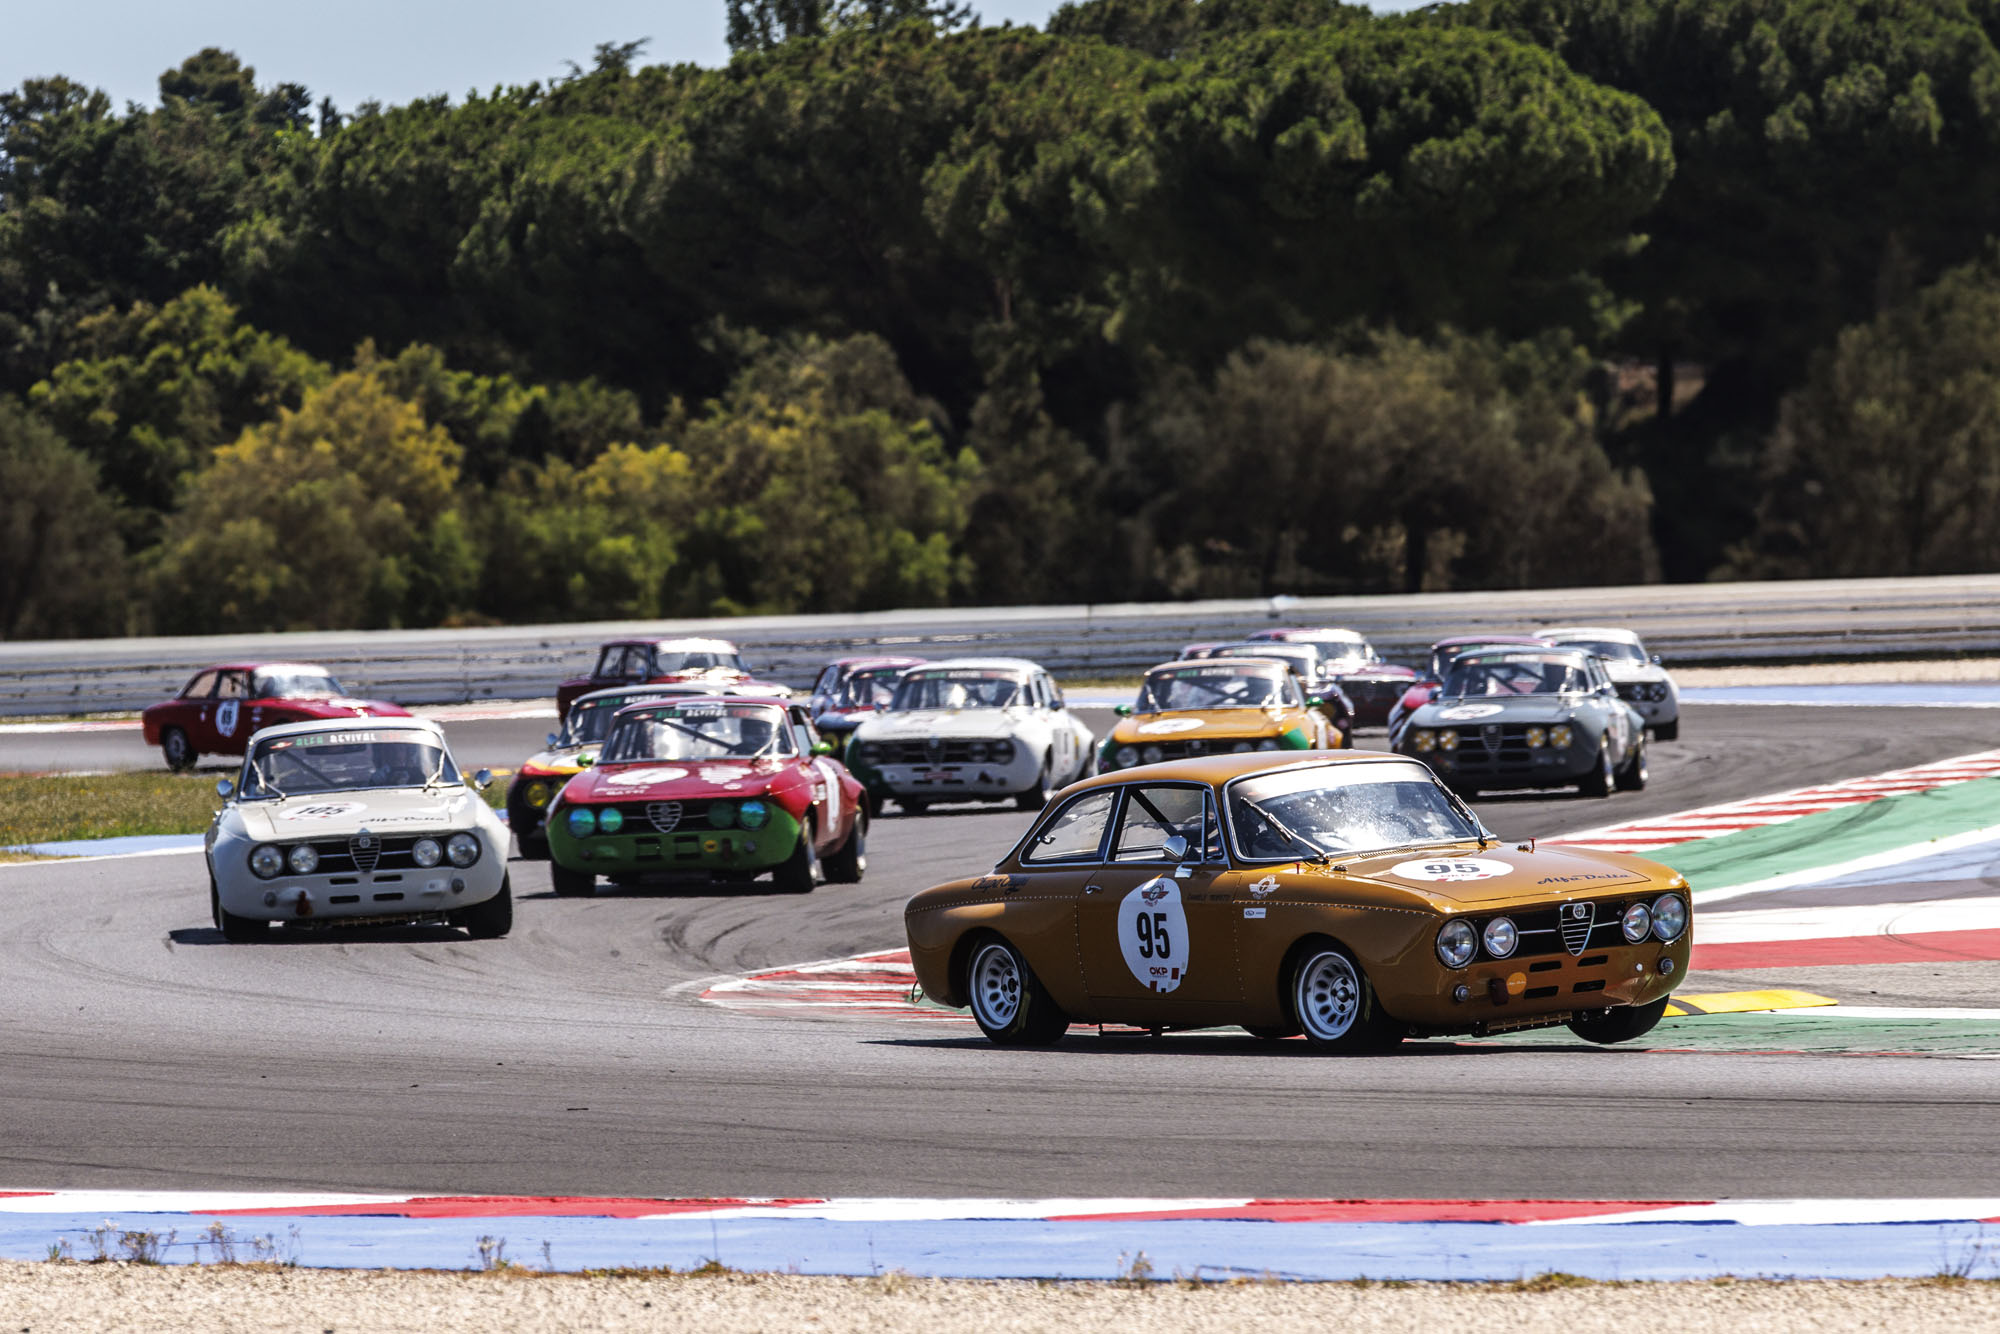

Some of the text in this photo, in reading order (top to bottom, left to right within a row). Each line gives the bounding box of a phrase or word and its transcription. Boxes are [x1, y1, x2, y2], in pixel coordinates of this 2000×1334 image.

[329, 732, 376, 744] REVIVAL
[296, 806, 351, 815] 105
[1424, 863, 1481, 874] 95
[1537, 876, 1582, 885] Alfa
[1136, 911, 1171, 959] 95
[1149, 966, 1169, 976] OKP
